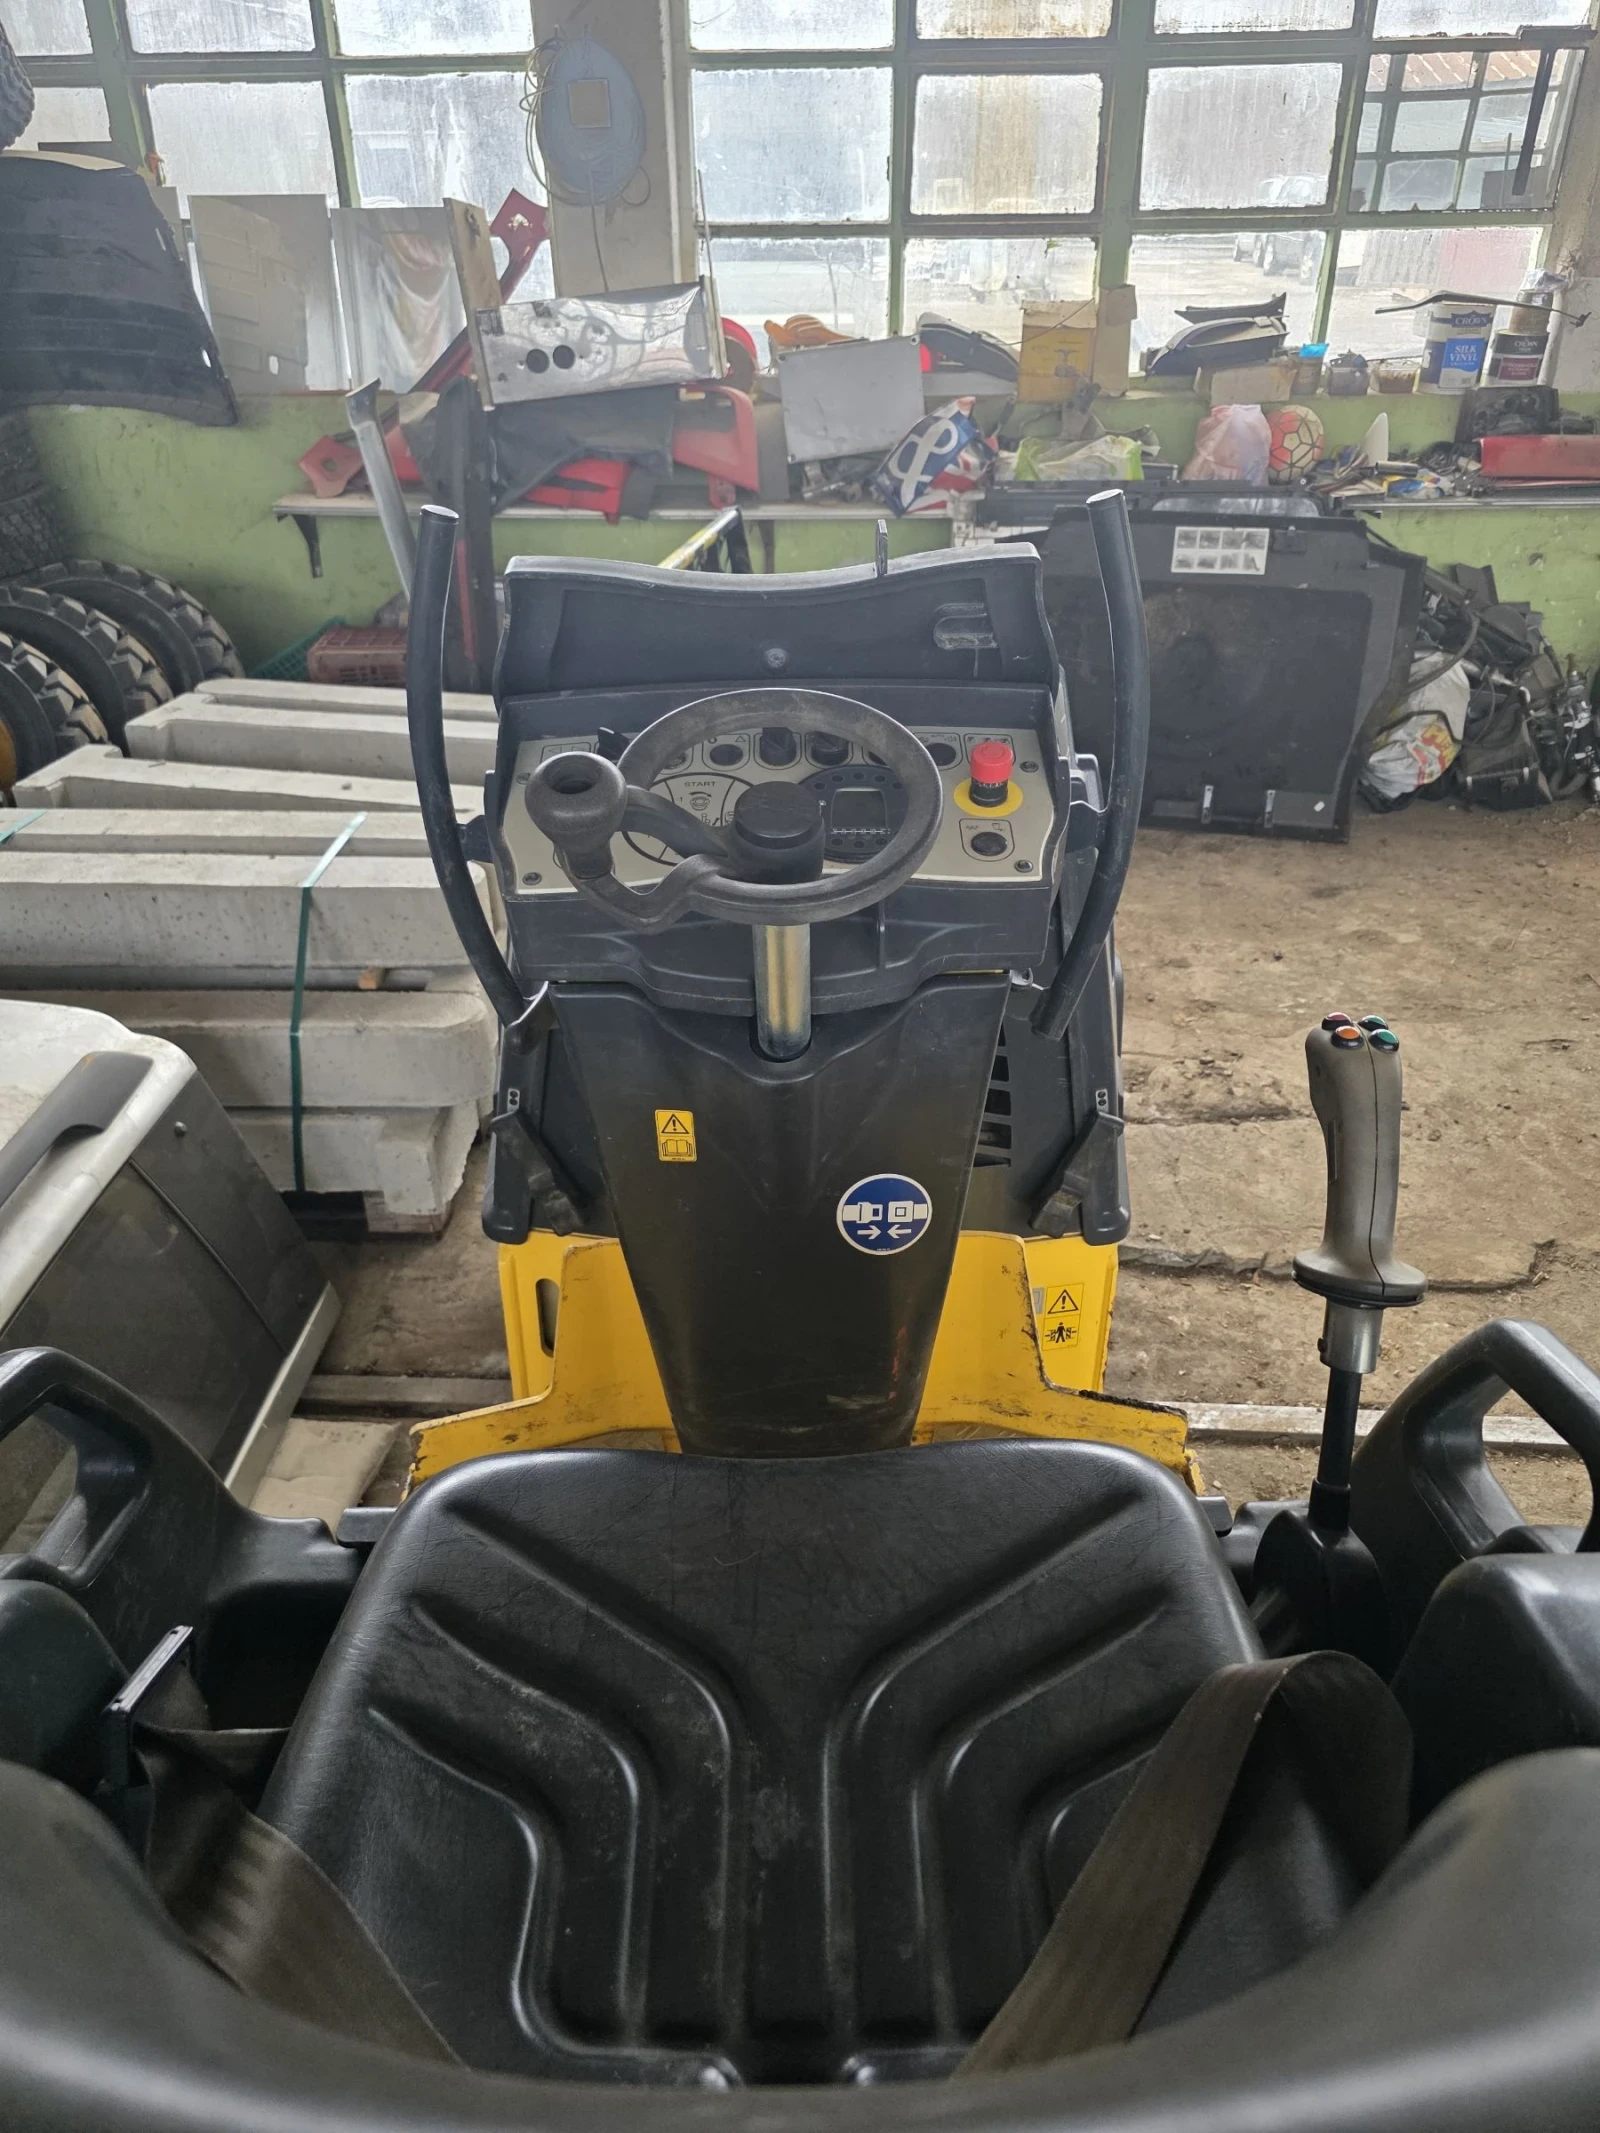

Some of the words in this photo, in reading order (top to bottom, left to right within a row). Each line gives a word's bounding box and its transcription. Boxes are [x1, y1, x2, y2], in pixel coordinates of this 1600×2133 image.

[1455, 316, 1487, 326] CROWN
[1455, 344, 1477, 353] SILK
[1450, 353, 1477, 361] VINYL
